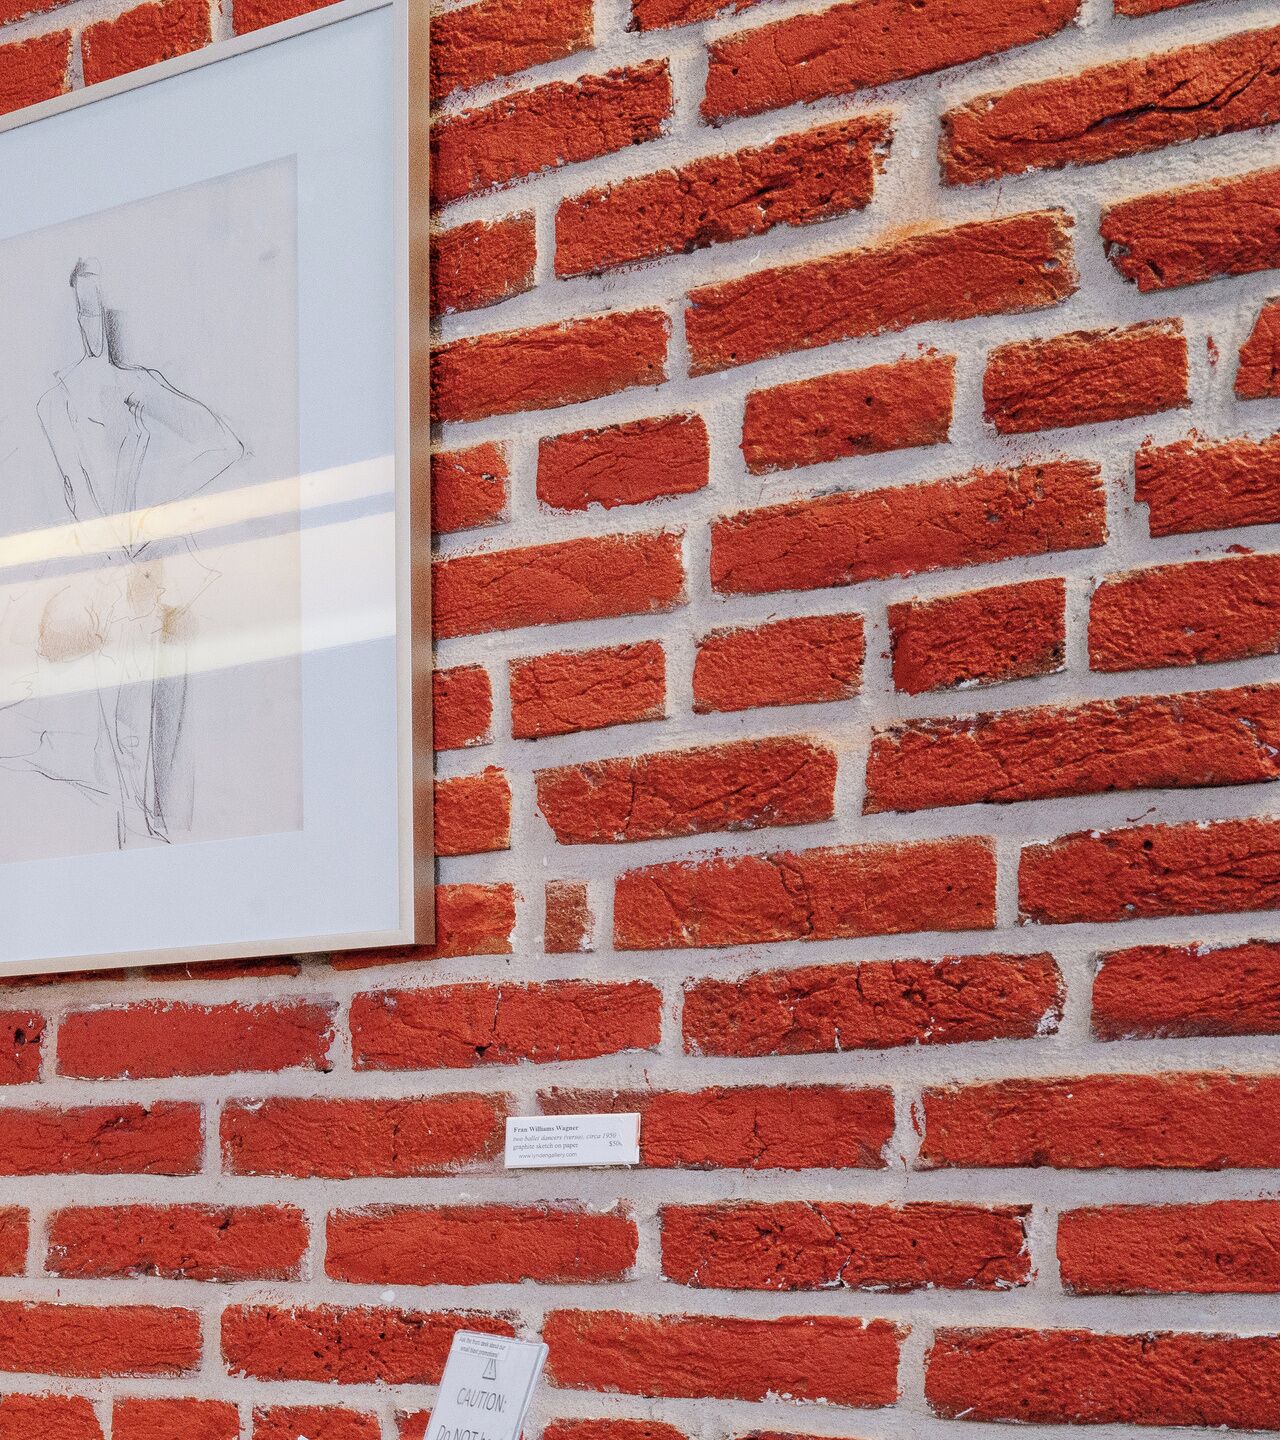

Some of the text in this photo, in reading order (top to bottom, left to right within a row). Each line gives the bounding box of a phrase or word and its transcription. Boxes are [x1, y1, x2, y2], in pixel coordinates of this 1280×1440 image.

[556, 1125, 578, 1133] Wagner
[513, 1143, 534, 1151] graphite
[456, 1387, 507, 1413] CAUTION:
